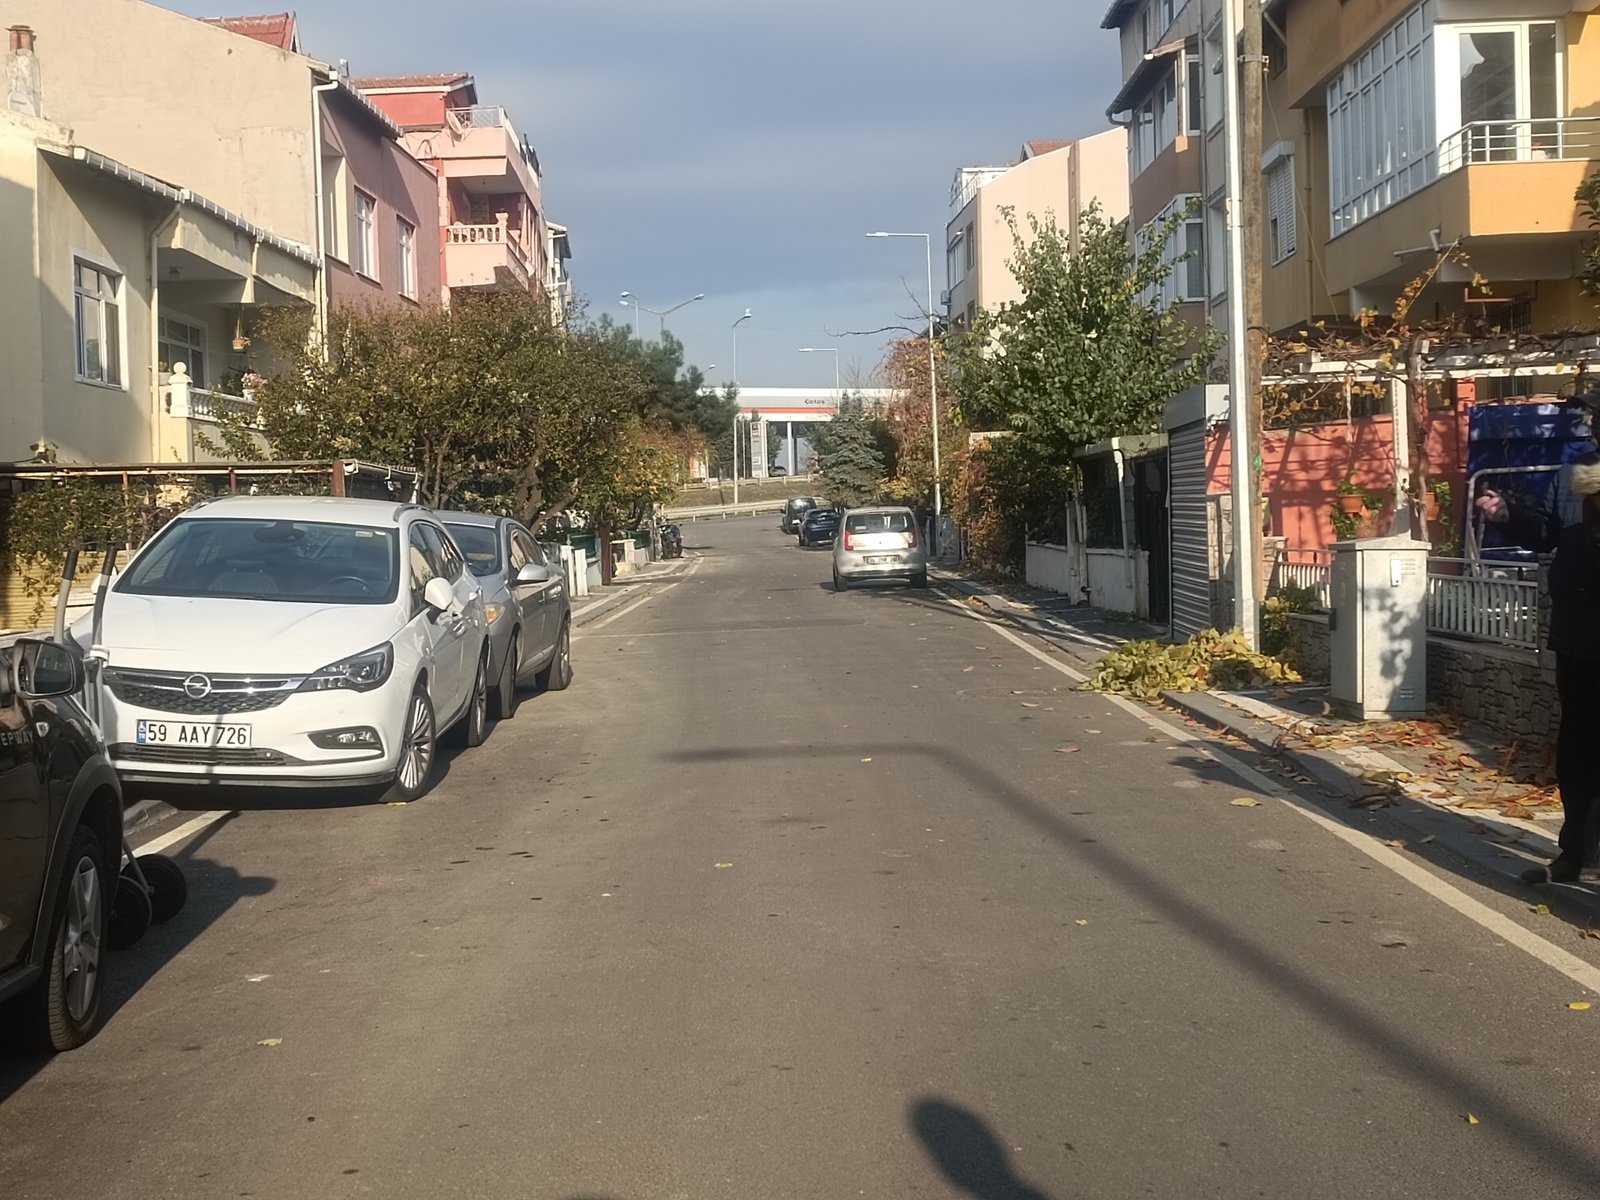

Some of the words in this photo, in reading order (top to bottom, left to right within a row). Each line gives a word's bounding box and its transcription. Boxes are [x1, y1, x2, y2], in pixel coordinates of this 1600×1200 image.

[148, 724, 167, 741] 59
[178, 725, 211, 743] AAY
[216, 727, 247, 745] 726
